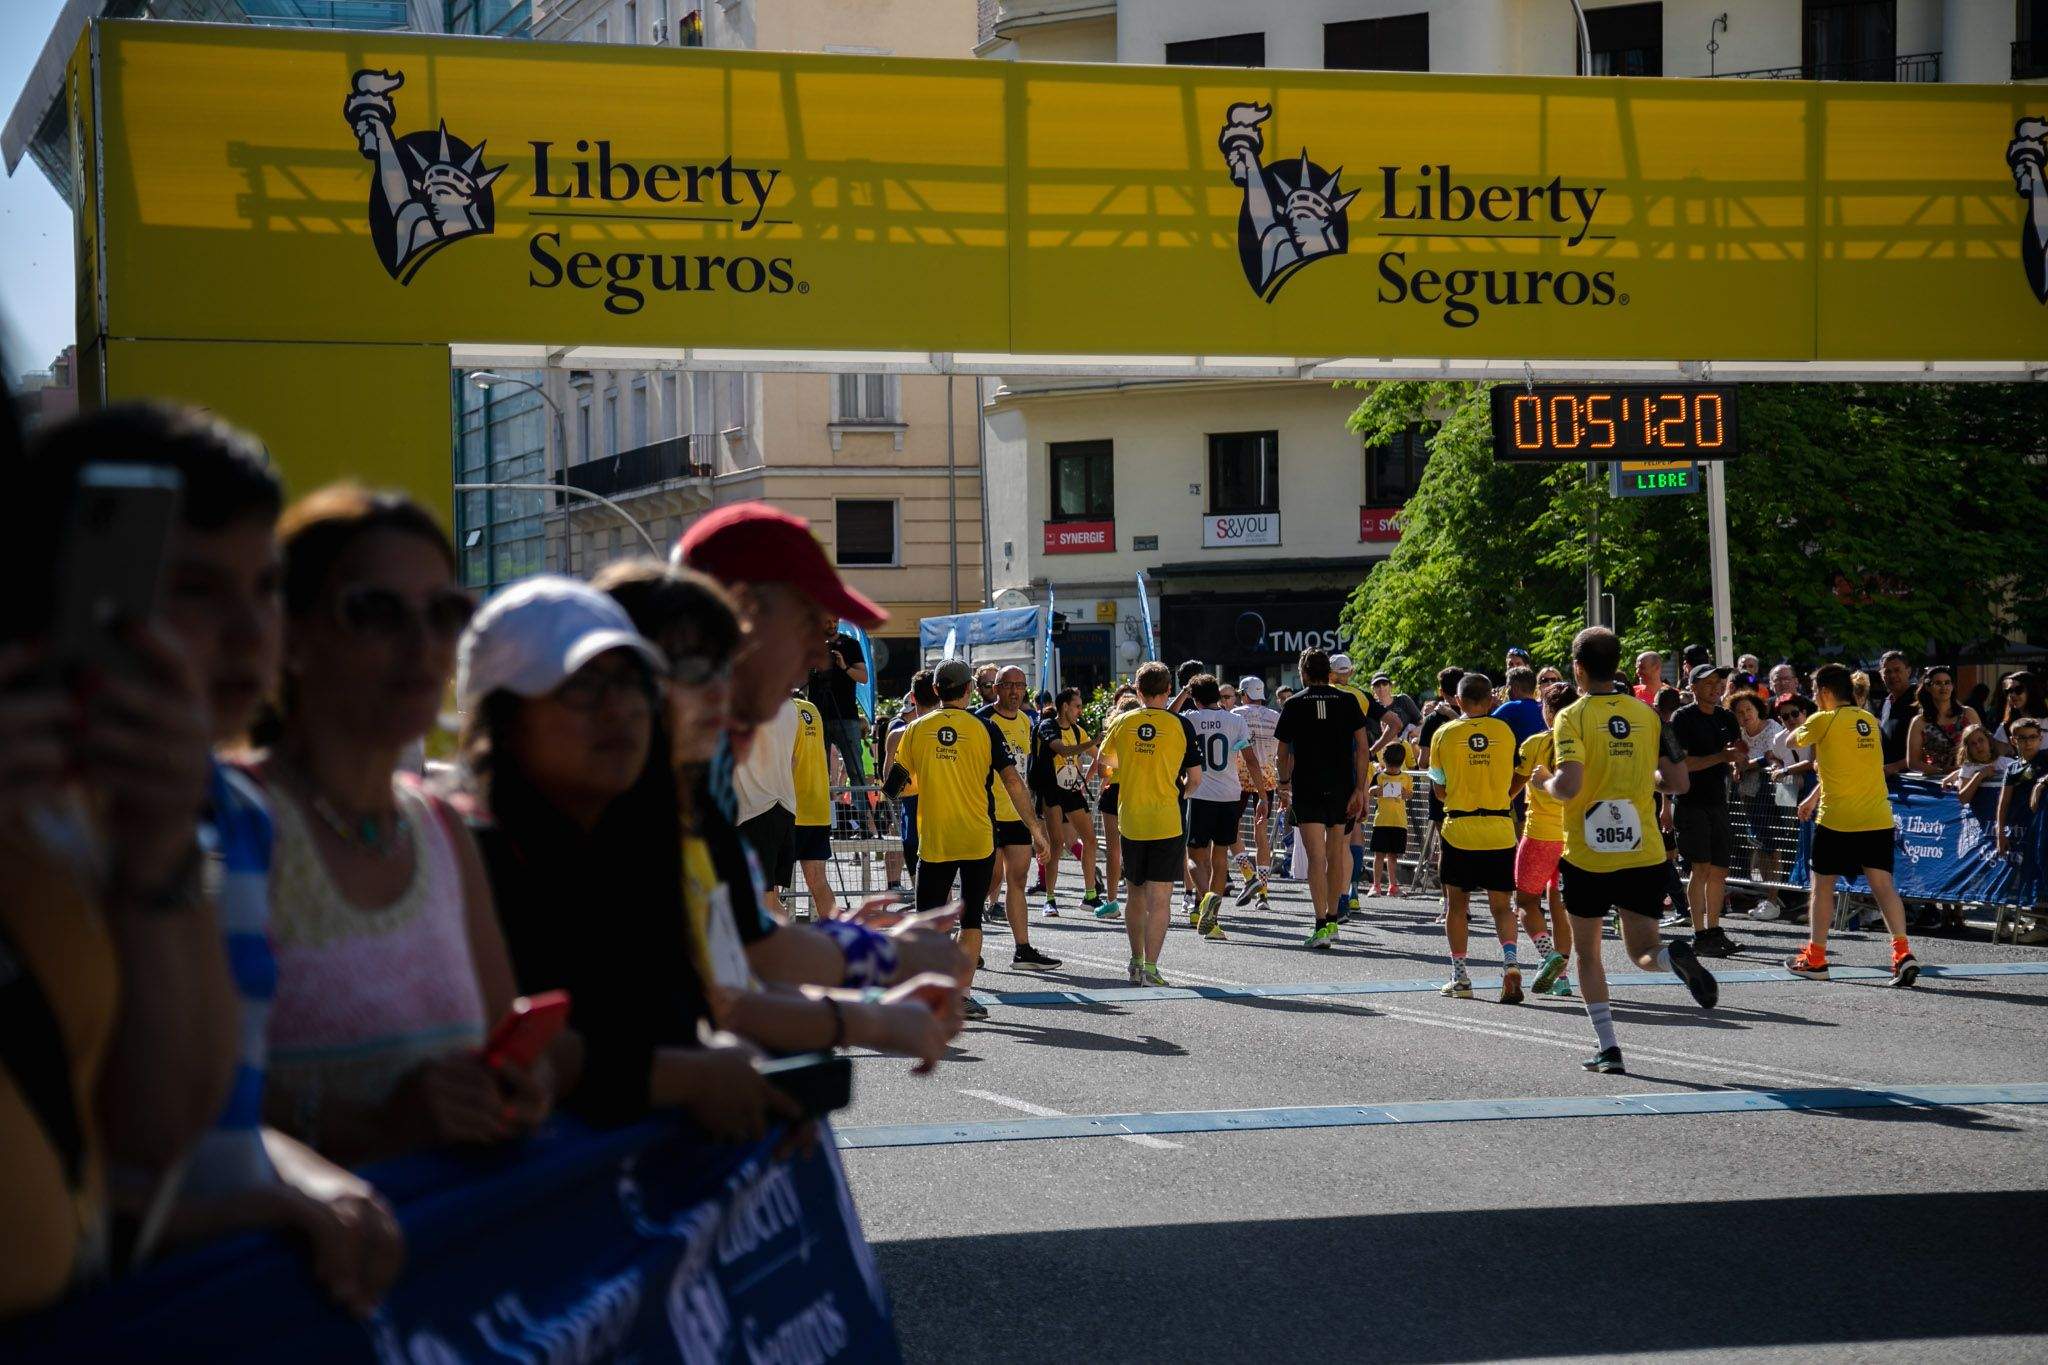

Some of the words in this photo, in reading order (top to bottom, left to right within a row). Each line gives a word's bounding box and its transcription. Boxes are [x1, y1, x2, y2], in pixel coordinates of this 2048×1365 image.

[528, 139, 782, 231] Liberty
[1378, 165, 1607, 247] Liberty
[1637, 472, 1688, 489] LIBRE
[1059, 531, 1105, 545] SYNERGIE
[1268, 629, 1357, 652] TMOSP
[1141, 726, 1153, 738] 13
[1200, 720, 1222, 730] CIRO
[1611, 720, 1627, 734] 13
[941, 730, 954, 742] 13
[1471, 737, 1485, 748] 13
[1595, 826, 1634, 843] 3054
[1906, 815, 1946, 841] Liberty
[1902, 840, 1944, 864] Seguros
